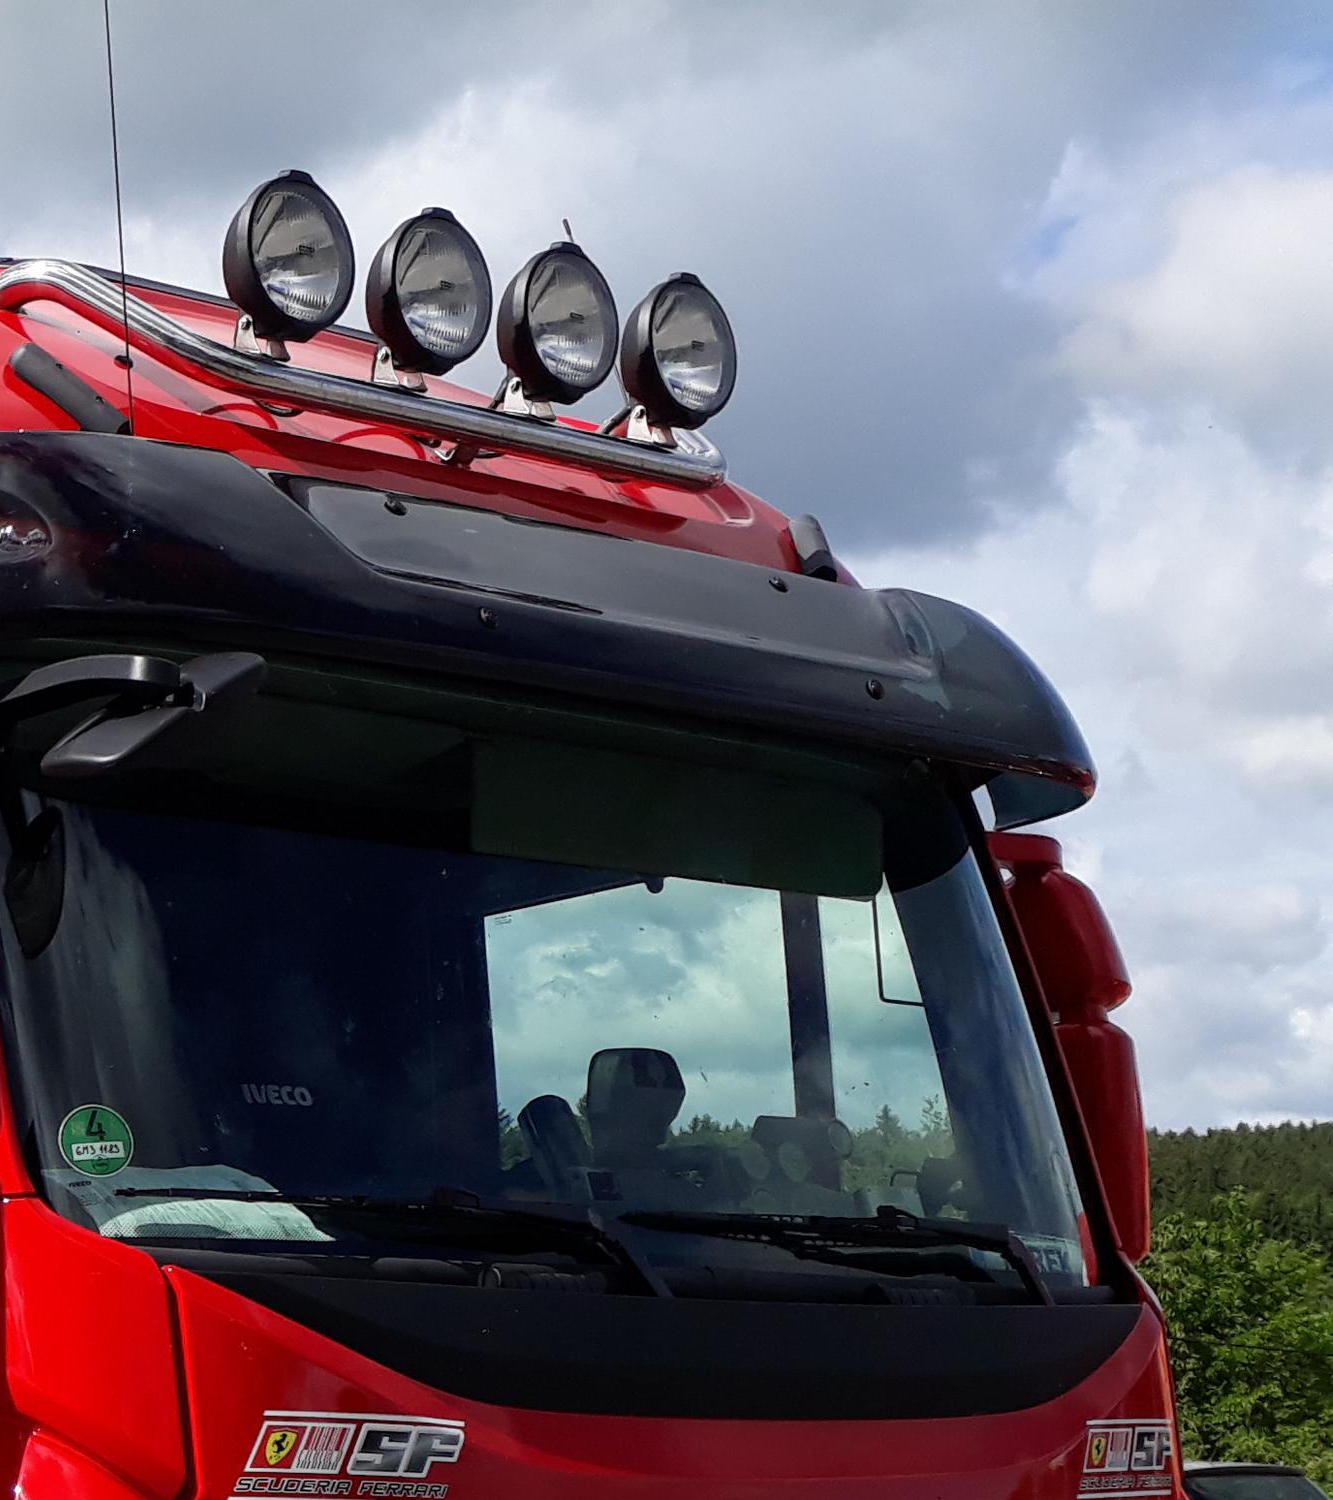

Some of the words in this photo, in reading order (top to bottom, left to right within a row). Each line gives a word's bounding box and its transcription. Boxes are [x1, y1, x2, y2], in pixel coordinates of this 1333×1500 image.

[241, 1084, 313, 1106] IVECO
[86, 1110, 105, 1141] 4
[346, 1423, 465, 1478] SF
[234, 1477, 352, 1494] SCUDERIA
[357, 1481, 449, 1498] FERRARI
